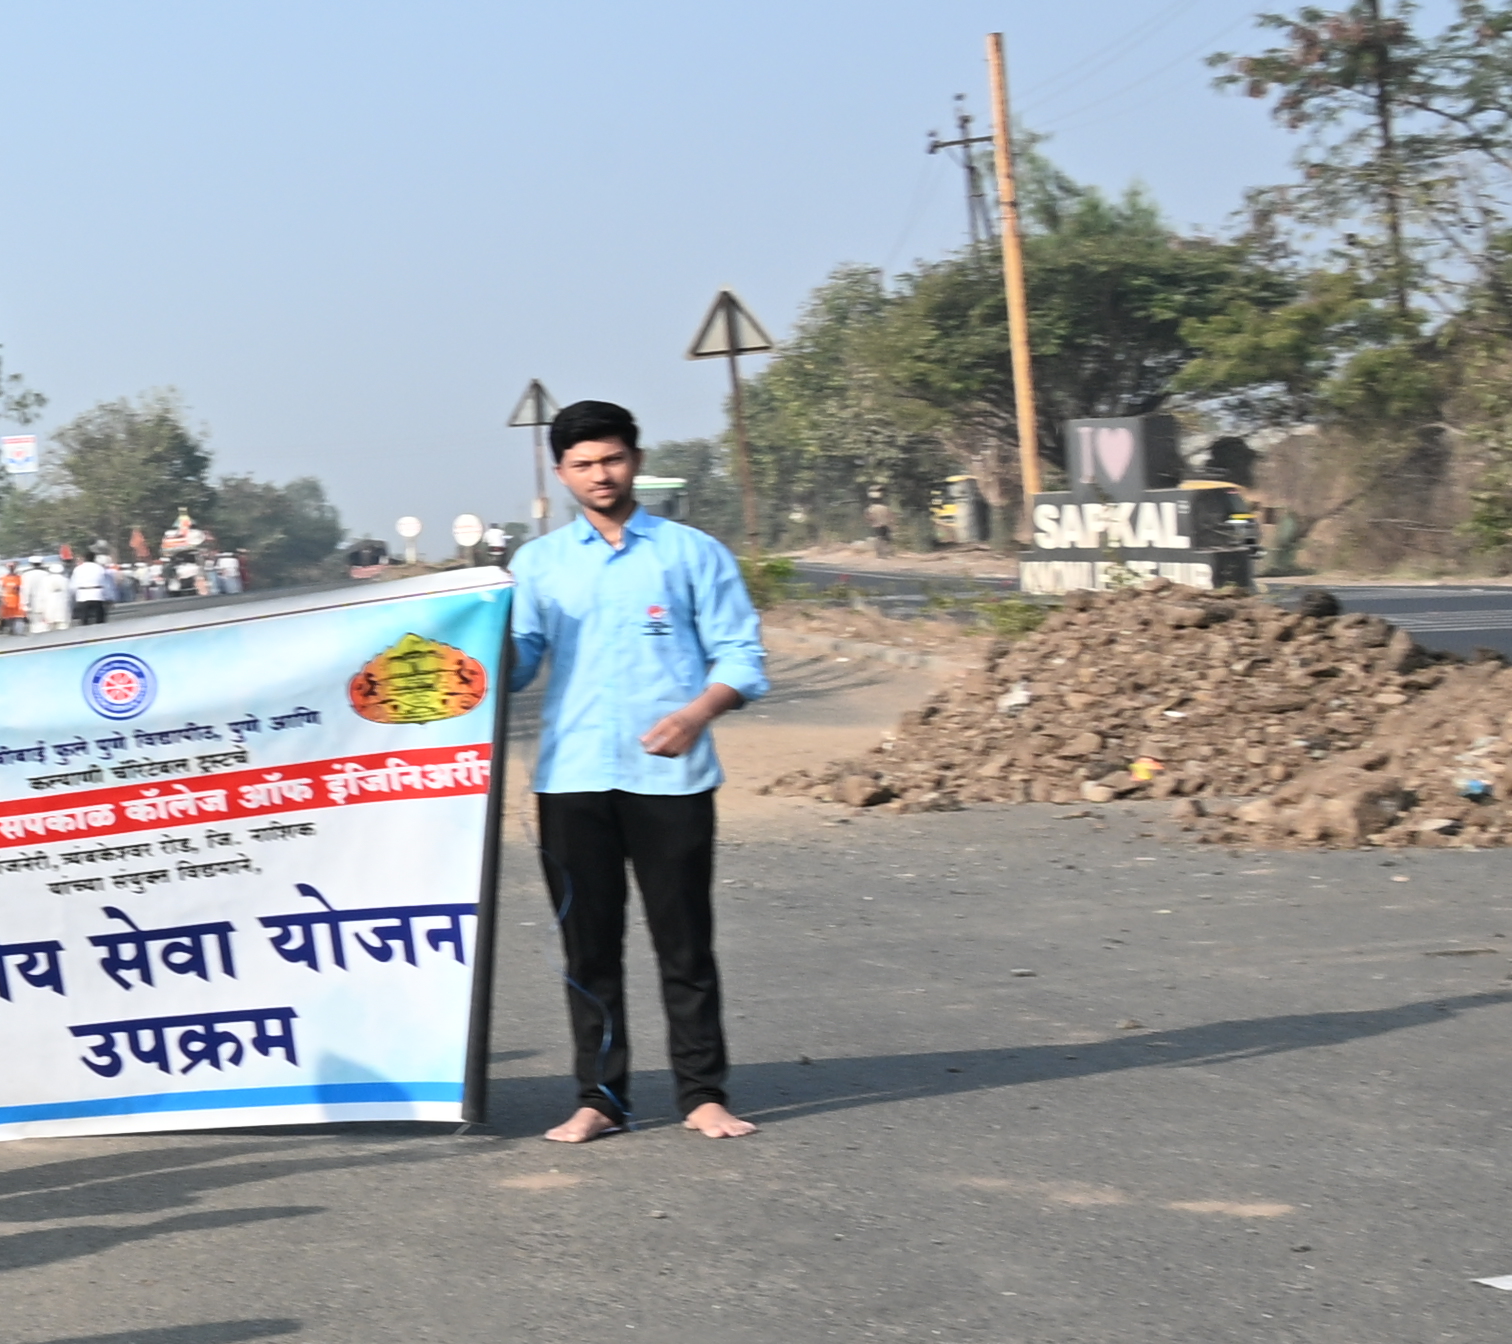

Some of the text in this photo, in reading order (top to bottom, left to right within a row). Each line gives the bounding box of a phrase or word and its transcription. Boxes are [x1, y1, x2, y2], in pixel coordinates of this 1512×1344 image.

[1075, 425, 1096, 484] I
[1032, 502, 1192, 549] SAPKAL
[51, 734, 91, 766] फुले
[93, 729, 130, 760] पुणे
[225, 712, 263, 743] पुणे
[268, 705, 323, 731] आणि
[25, 763, 106, 791] कल्याणी
[119, 782, 230, 824] कॉलेज
[237, 771, 314, 808] ऑफ
[204, 828, 242, 849] जि.
[246, 819, 317, 842] नाशिक
[87, 905, 238, 992] सेवा
[256, 882, 478, 974] योजन
[66, 1006, 300, 1079] उपक्रम
